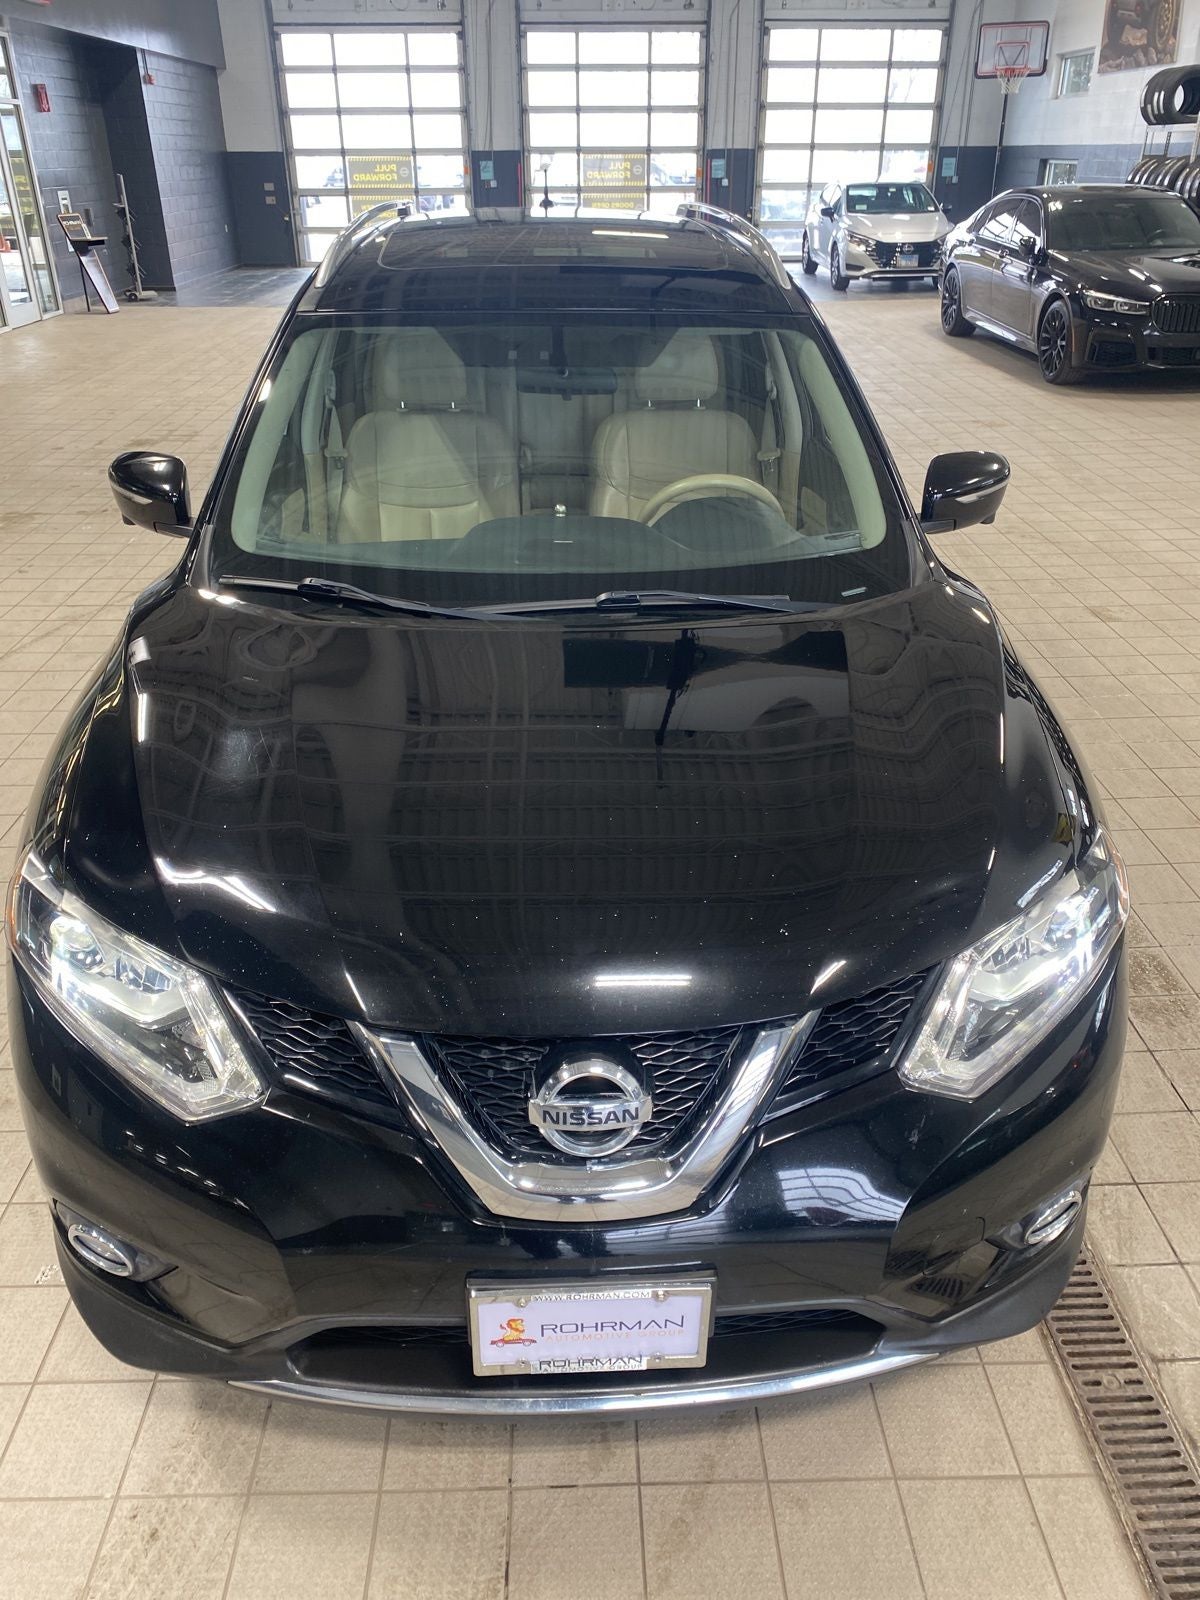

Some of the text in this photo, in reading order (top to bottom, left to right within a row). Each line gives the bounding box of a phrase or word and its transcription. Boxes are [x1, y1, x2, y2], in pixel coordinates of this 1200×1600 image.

[542, 1107, 639, 1126] NISSAN
[535, 1291, 650, 1301] WWW.ROHRMAN.COM
[541, 1315, 684, 1337] ROHRMAN
[546, 1329, 684, 1342] AUTOMOTIVE GROUP
[539, 1354, 642, 1370] ROHRMAN
